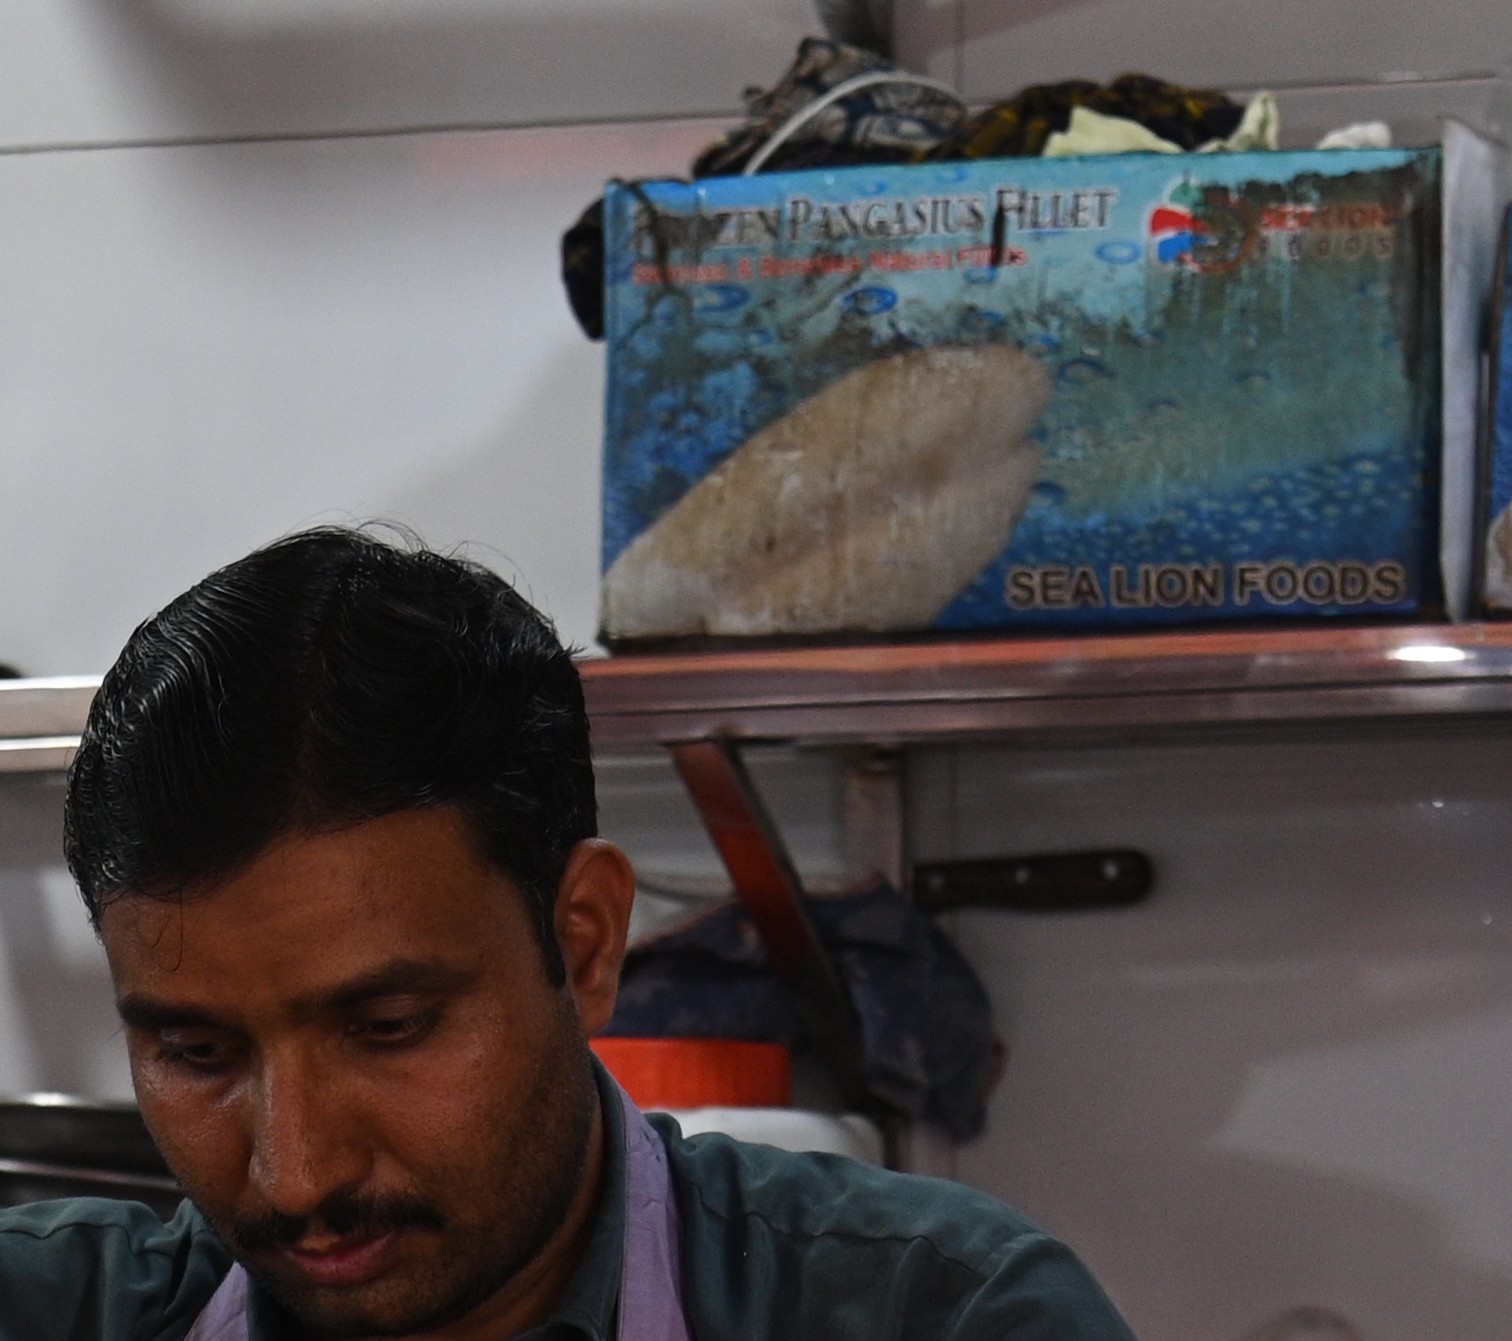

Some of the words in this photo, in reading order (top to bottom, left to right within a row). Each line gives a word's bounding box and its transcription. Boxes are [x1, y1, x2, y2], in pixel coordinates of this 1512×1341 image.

[633, 206, 781, 249] FZEN
[790, 198, 985, 240] PANGASIUS
[994, 187, 1118, 231] FILLET
[1008, 568, 1105, 608] SEA
[1115, 565, 1223, 605] LION
[1237, 563, 1407, 604] FOODS
